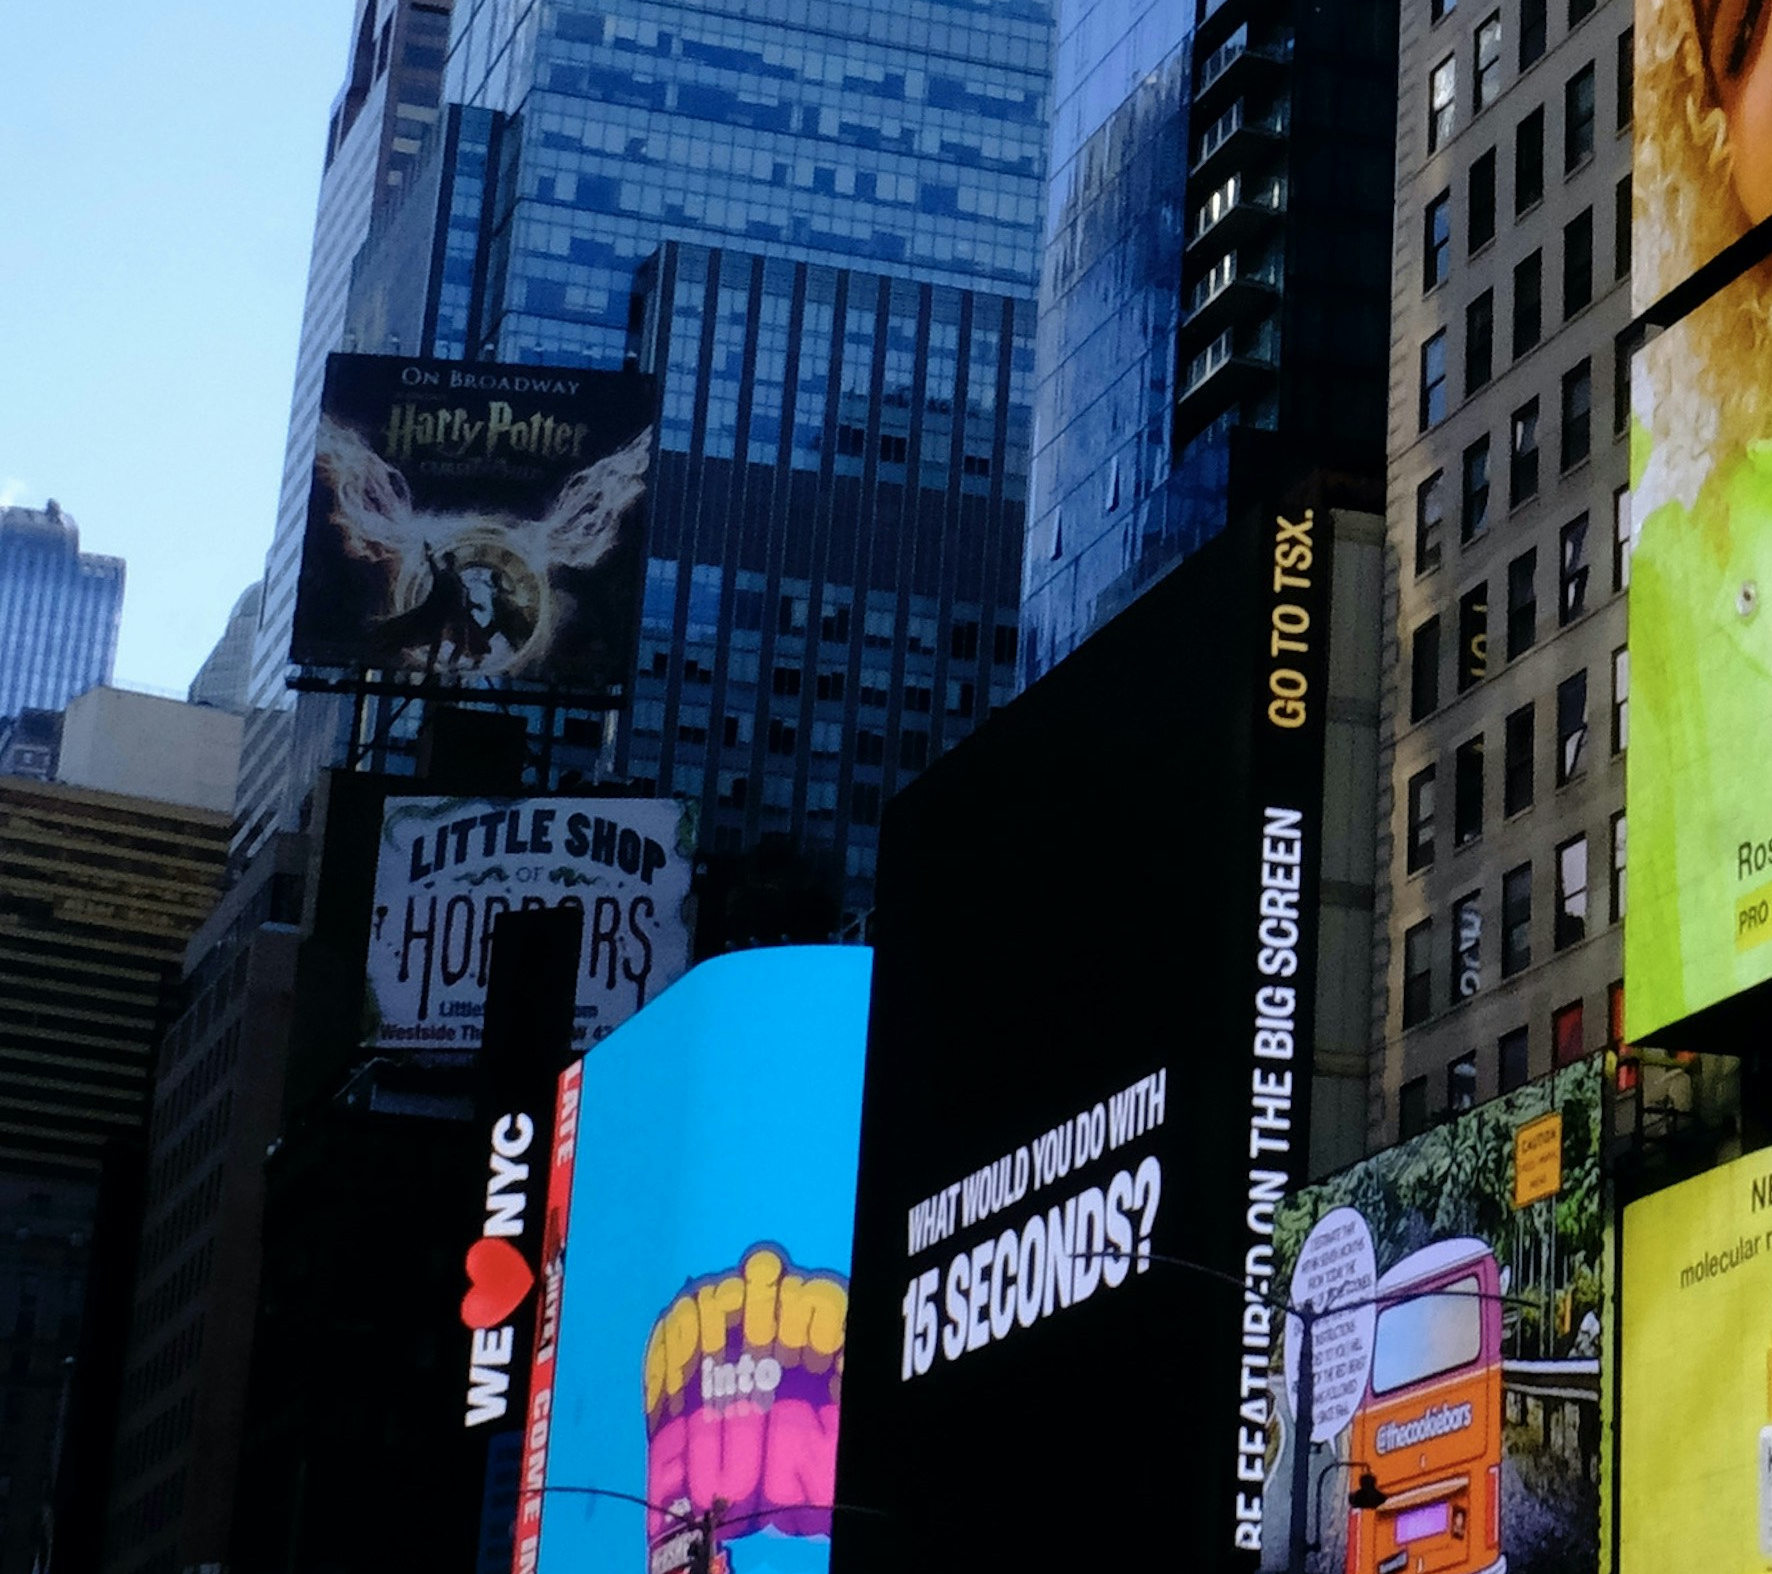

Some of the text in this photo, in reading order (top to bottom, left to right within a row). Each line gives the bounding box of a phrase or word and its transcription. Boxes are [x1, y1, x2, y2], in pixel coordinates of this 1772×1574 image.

[385, 400, 589, 458] Harry Potter
[1267, 507, 1315, 730] GO TO TSX.
[410, 809, 667, 885] LITTLE SHOP
[515, 866, 545, 883] OF
[1257, 806, 1304, 978] SCREEN
[1738, 899, 1770, 935] PRO
[397, 895, 654, 1021] HORRS
[1253, 984, 1299, 1061] BIG
[1249, 1066, 1292, 1159] THE
[907, 1066, 1167, 1257] WHAT WOULD YOU DO WITH
[1246, 1169, 1289, 1237] ON
[464, 1110, 535, 1429] WE NYC
[900, 1265, 941, 1383] 15
[942, 1154, 1162, 1361] SECONDS?
[1679, 1231, 1764, 1290] molecular
[701, 1353, 782, 1398] into
[523, 1388, 552, 1524] COME
